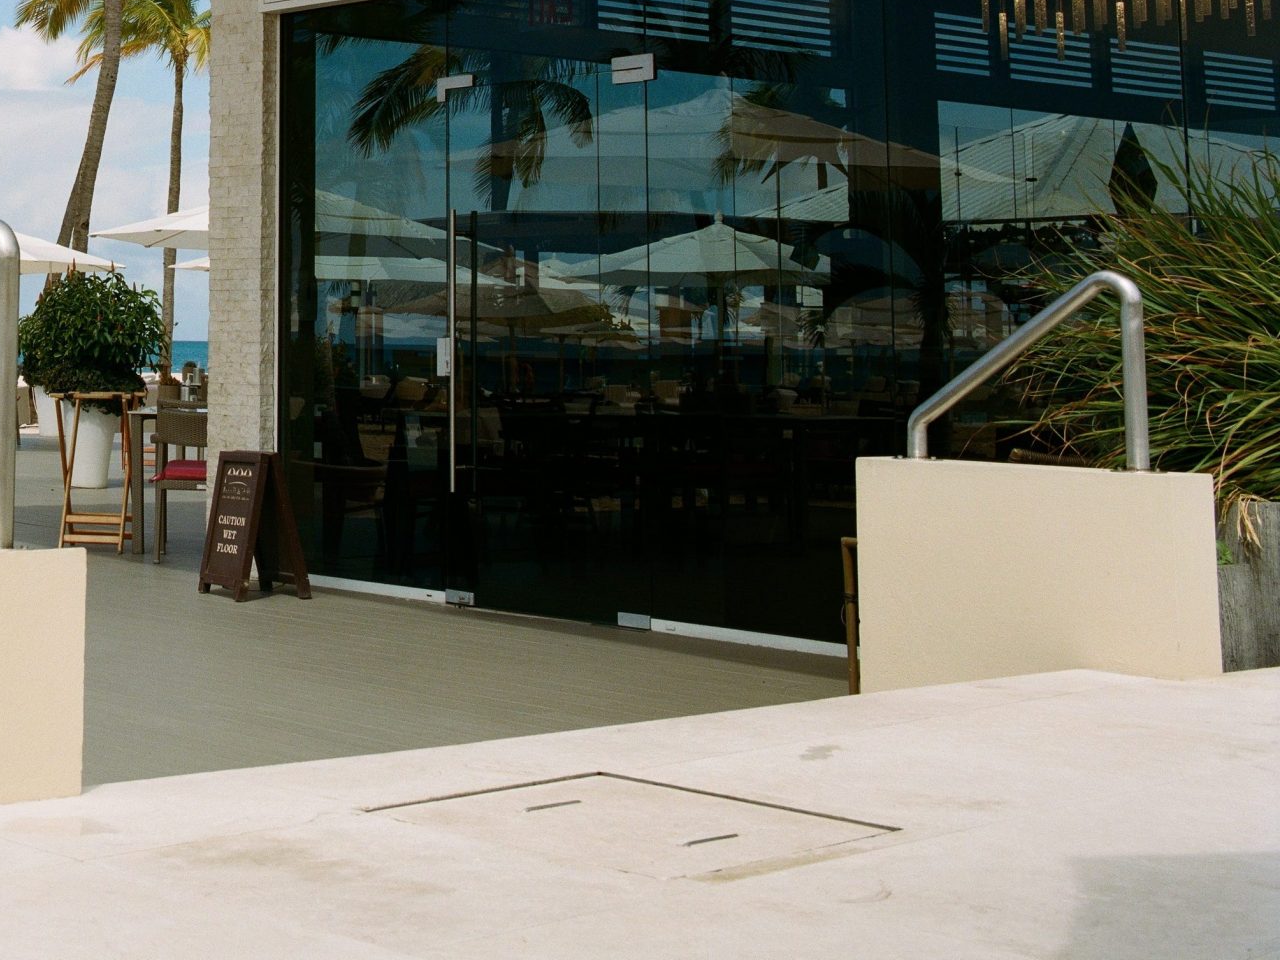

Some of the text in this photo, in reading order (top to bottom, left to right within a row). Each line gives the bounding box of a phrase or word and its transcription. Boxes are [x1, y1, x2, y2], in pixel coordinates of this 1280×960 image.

[218, 515, 246, 526] CAUTION
[223, 529, 237, 540] WET
[216, 543, 238, 554] FLOOR
